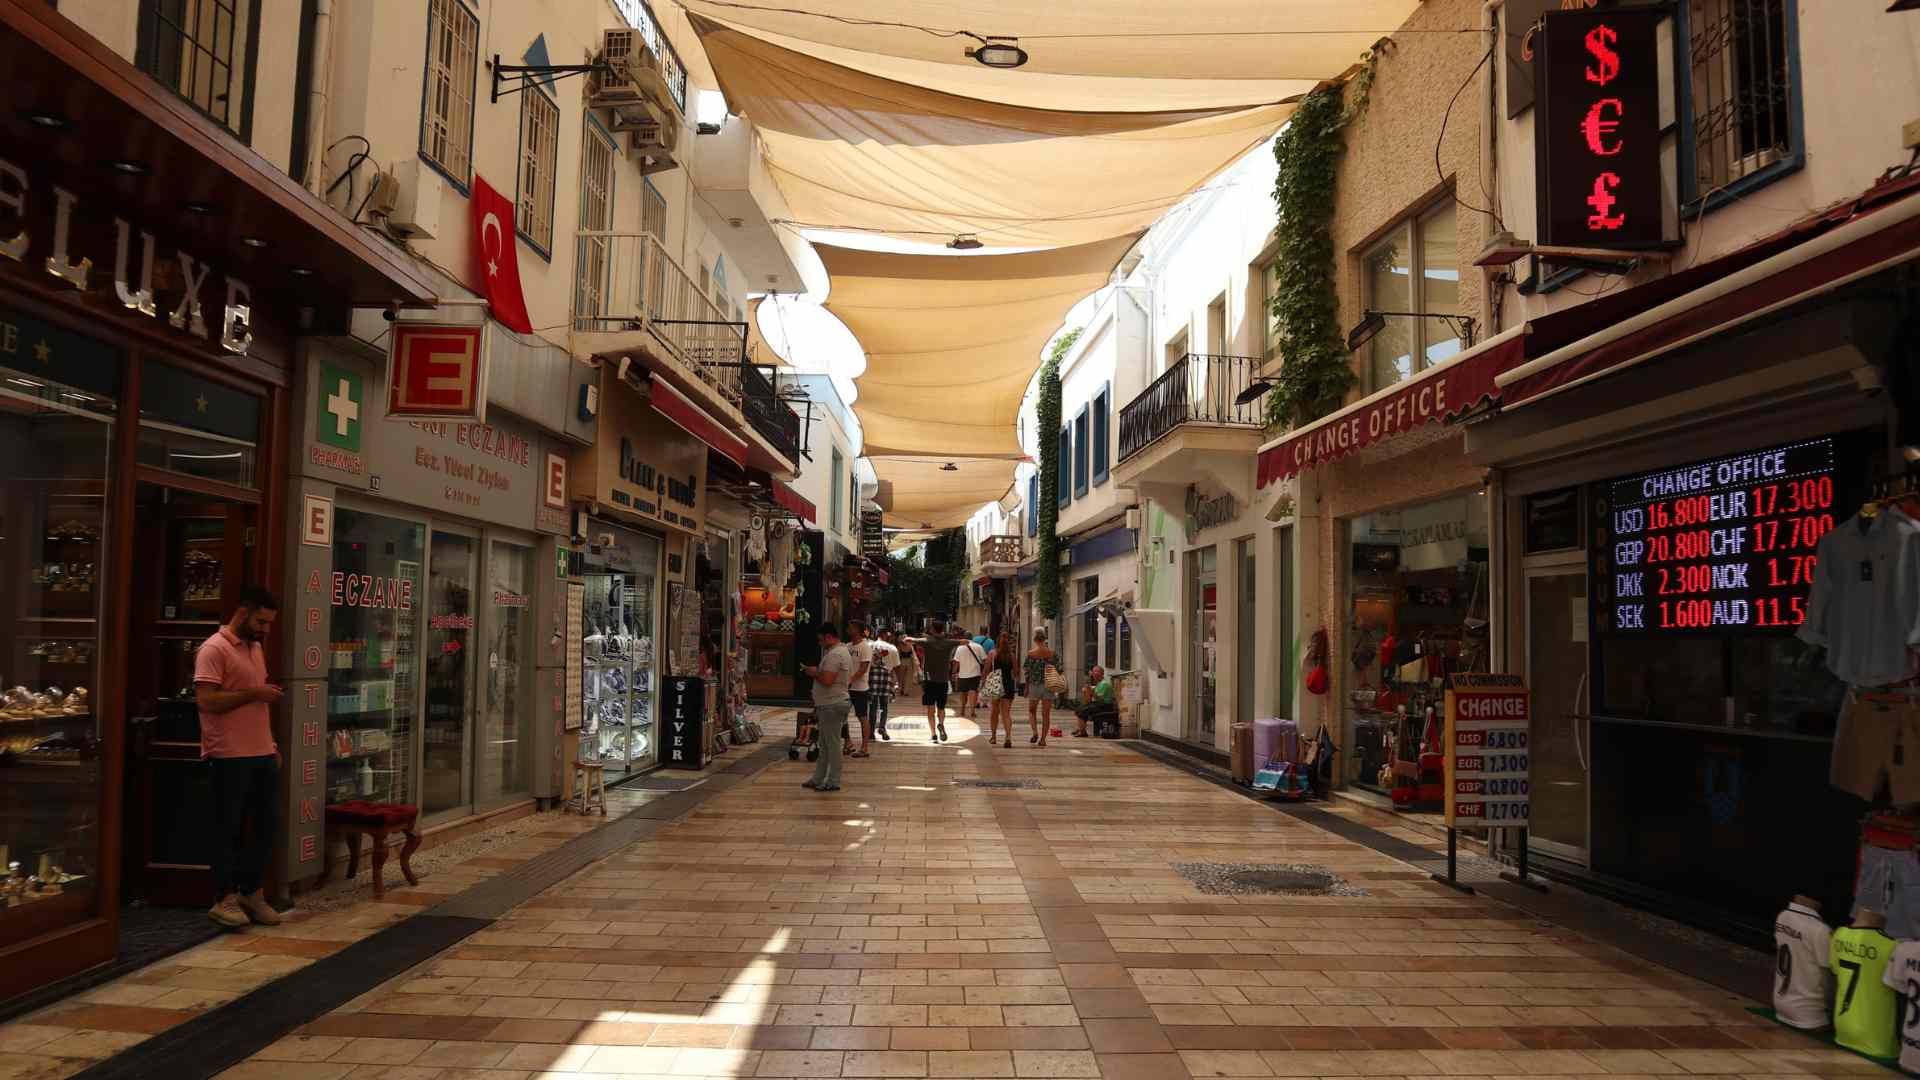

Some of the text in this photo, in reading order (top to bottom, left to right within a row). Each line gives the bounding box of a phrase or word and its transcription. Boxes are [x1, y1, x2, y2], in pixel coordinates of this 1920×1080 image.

[1583, 24, 1620, 87] $
[1579, 98, 1624, 157] €
[1585, 171, 1626, 231] £
[408, 336, 468, 405] E
[1294, 378, 1447, 466] CHANGE OFFICE
[457, 422, 529, 466] ECZANE
[551, 463, 562, 497] E
[1643, 451, 1787, 498] CHANGE OFFICE
[311, 507, 325, 535] E
[1614, 476, 1834, 534] USD 16.800 EUR 17.300
[1615, 541, 1644, 565] GBP
[1646, 529, 1711, 563] 20.800
[1711, 526, 1747, 556] CHF
[331, 571, 412, 610] ECZANE
[1616, 555, 1817, 598] DKK 2.300 NOK 1.70
[1616, 597, 1808, 629] SEK 1.600 AUD 11.5
[299, 569, 322, 864] APOTHEKE
[671, 680, 685, 762] SILVER
[1459, 697, 1525, 717] CHANGE
[1458, 733, 1481, 744] USD
[1458, 758, 1482, 768] EUR
[1457, 782, 1481, 792] GBP
[1458, 804, 1481, 815] CHF
[1839, 959, 1862, 1016] 7
